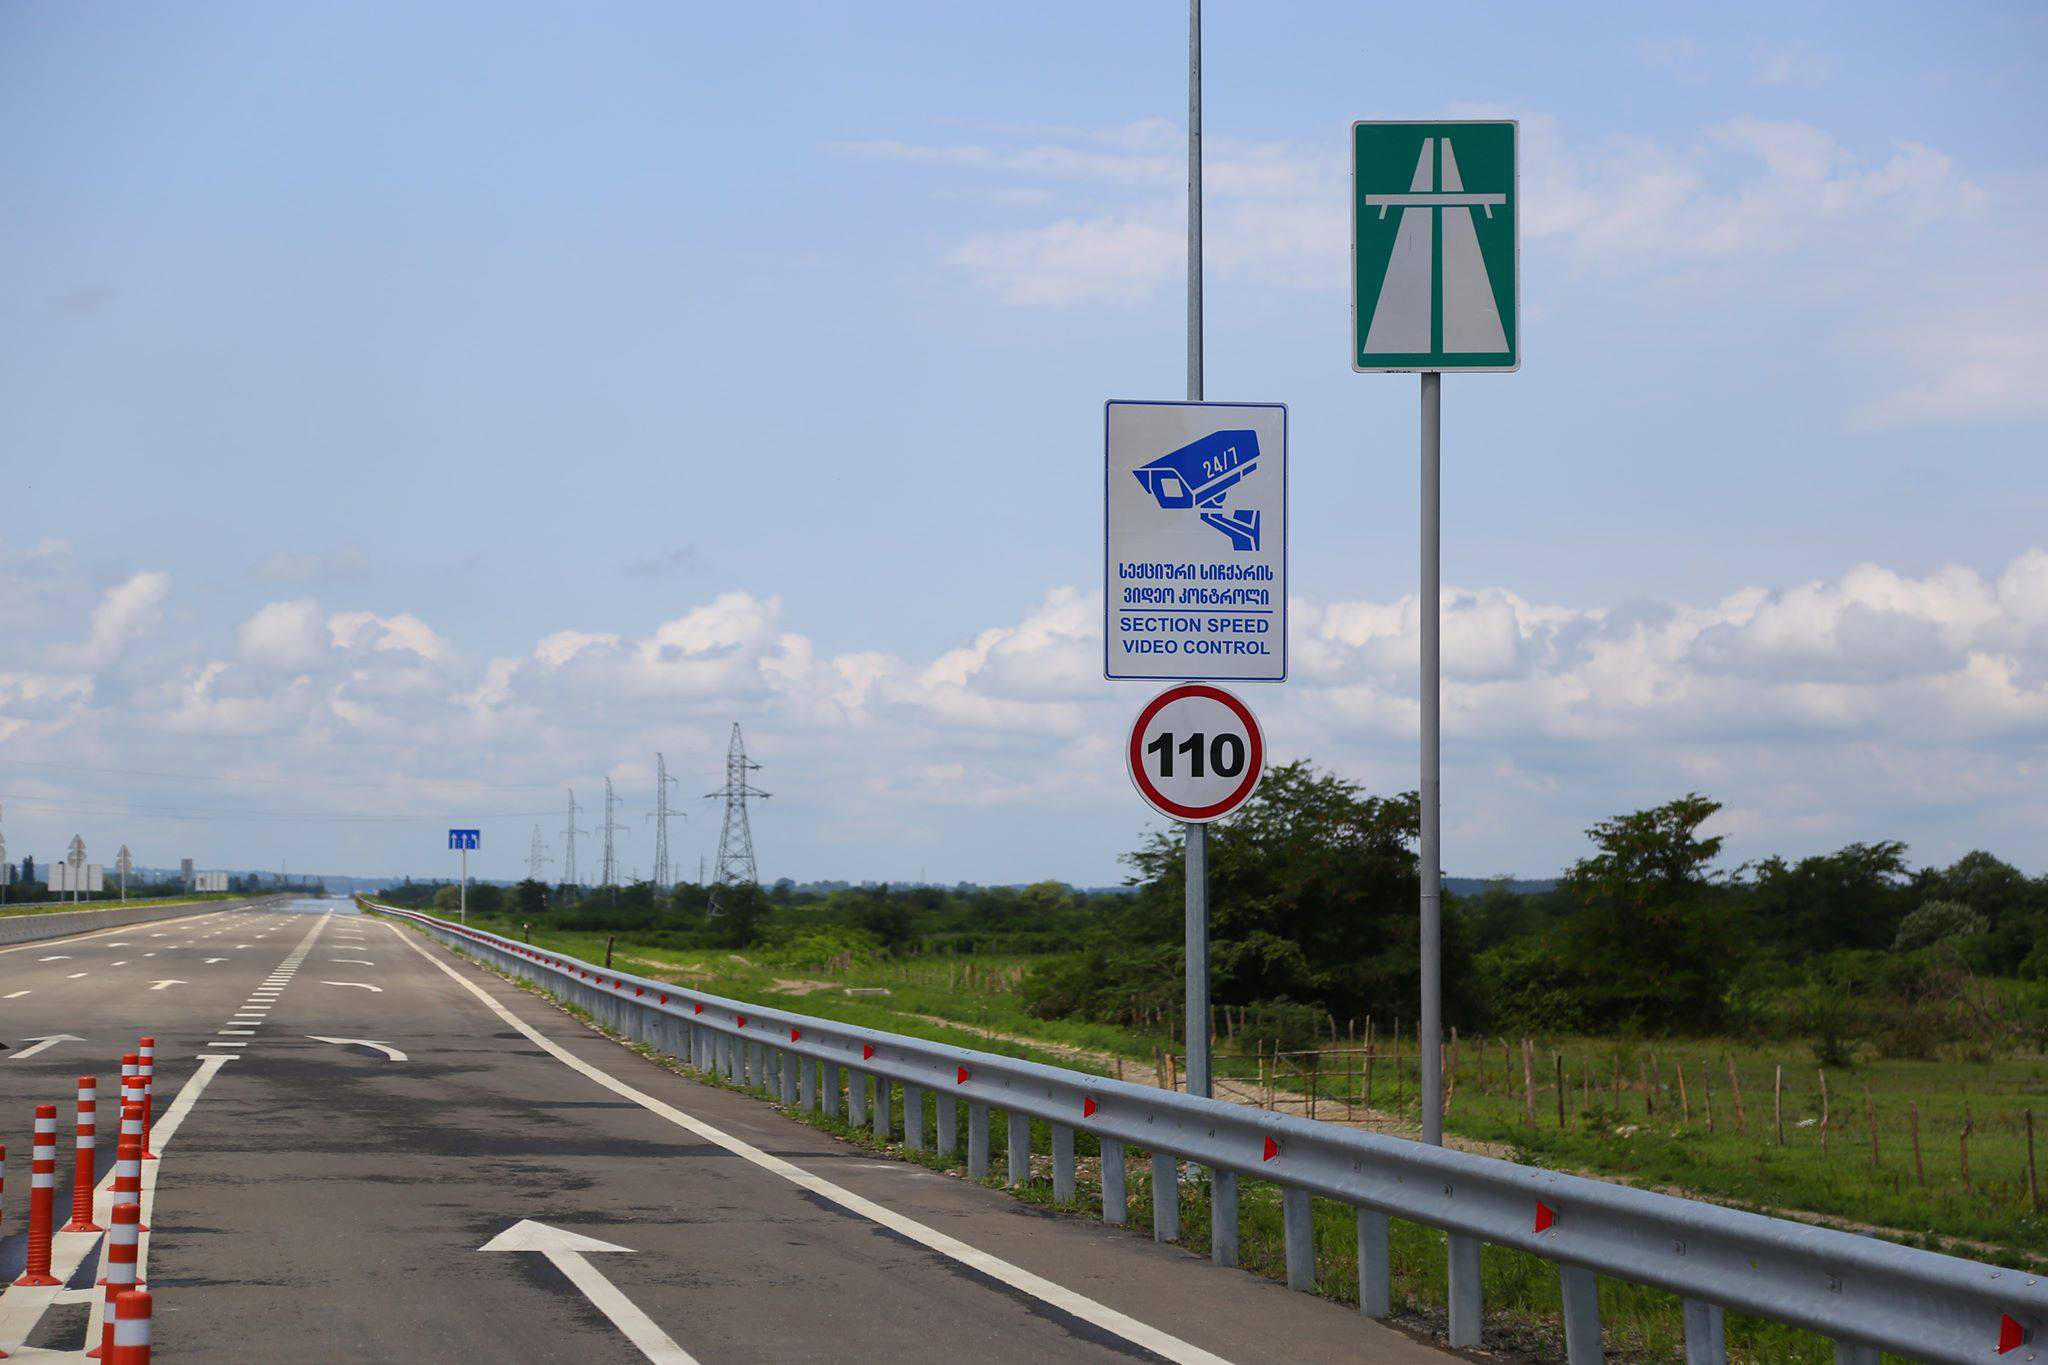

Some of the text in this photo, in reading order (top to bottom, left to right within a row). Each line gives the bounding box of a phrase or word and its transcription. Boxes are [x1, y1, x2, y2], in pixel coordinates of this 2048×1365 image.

[1203, 447, 1239, 478] 24/7
[1119, 563, 1274, 581] სექციური სიჩქარის
[1123, 587, 1270, 605] ვიდეო კონტროლი
[1120, 617, 1269, 633] SECTION SPEED
[1123, 639, 1270, 655] VIDEO CONTROL
[1148, 733, 1245, 777] 110
